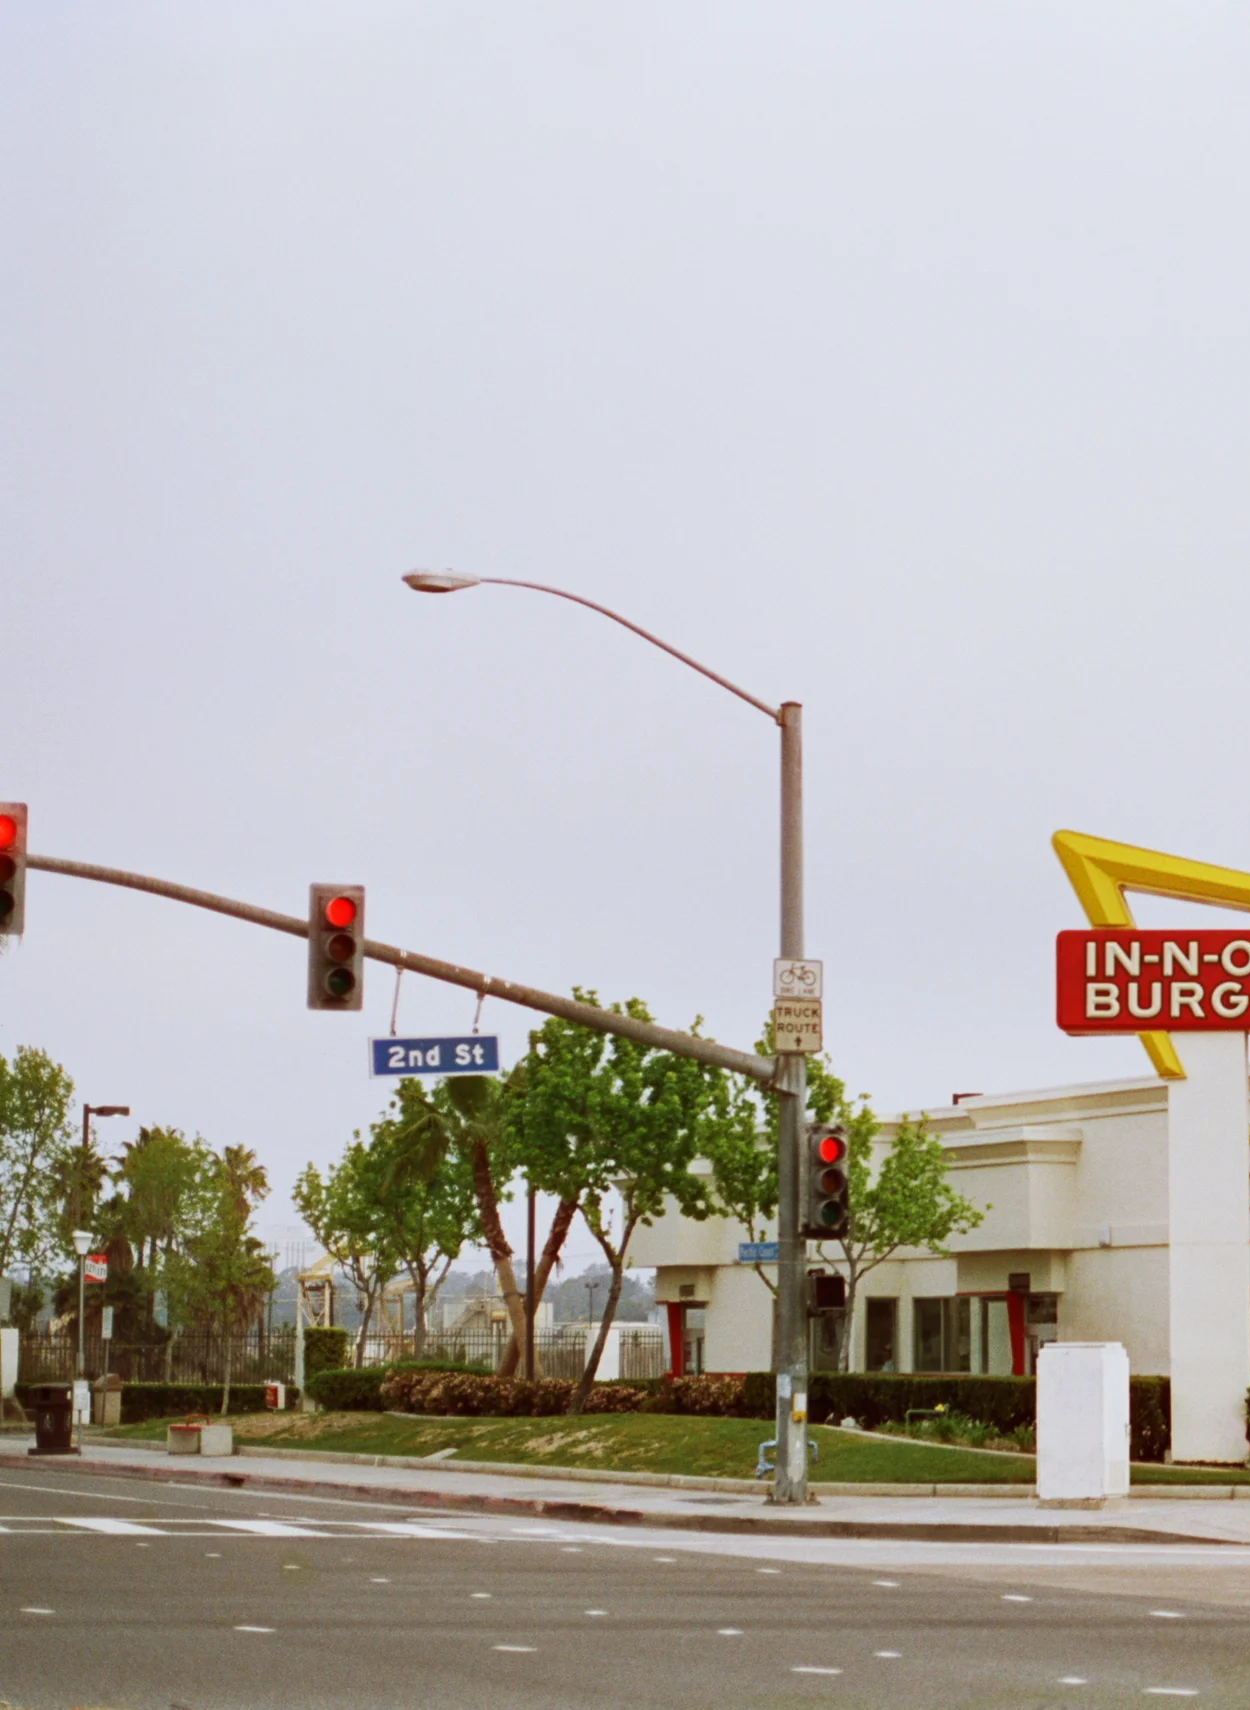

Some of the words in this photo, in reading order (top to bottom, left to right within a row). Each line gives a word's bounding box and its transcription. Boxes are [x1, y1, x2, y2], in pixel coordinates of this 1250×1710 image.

[776, 1007, 819, 1018] TRUCK
[776, 1022, 819, 1034] ROUTE
[388, 1045, 441, 1068] 2nd
[455, 1043, 485, 1065] St
